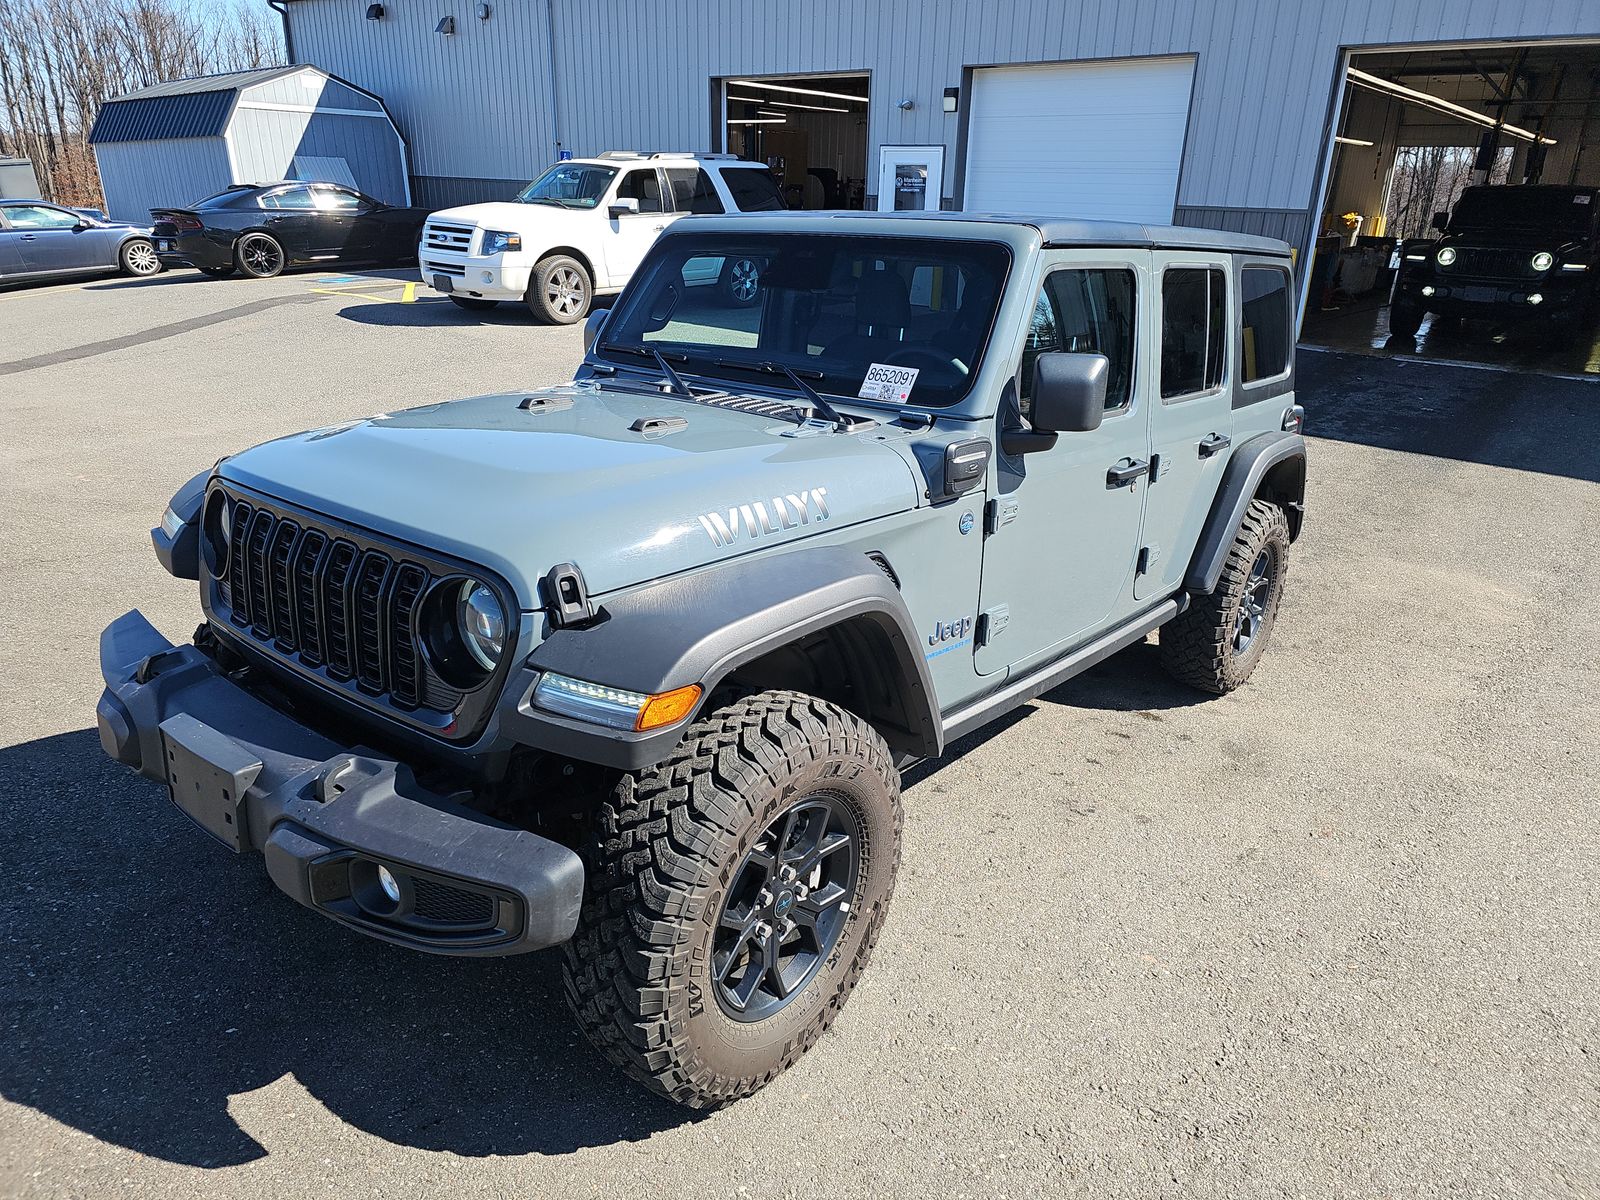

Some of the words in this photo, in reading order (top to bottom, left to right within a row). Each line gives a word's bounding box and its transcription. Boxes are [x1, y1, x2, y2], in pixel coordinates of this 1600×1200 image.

[867, 367, 916, 386] 8652091
[697, 486, 831, 549] WILLYS
[928, 616, 972, 646] Jeep
